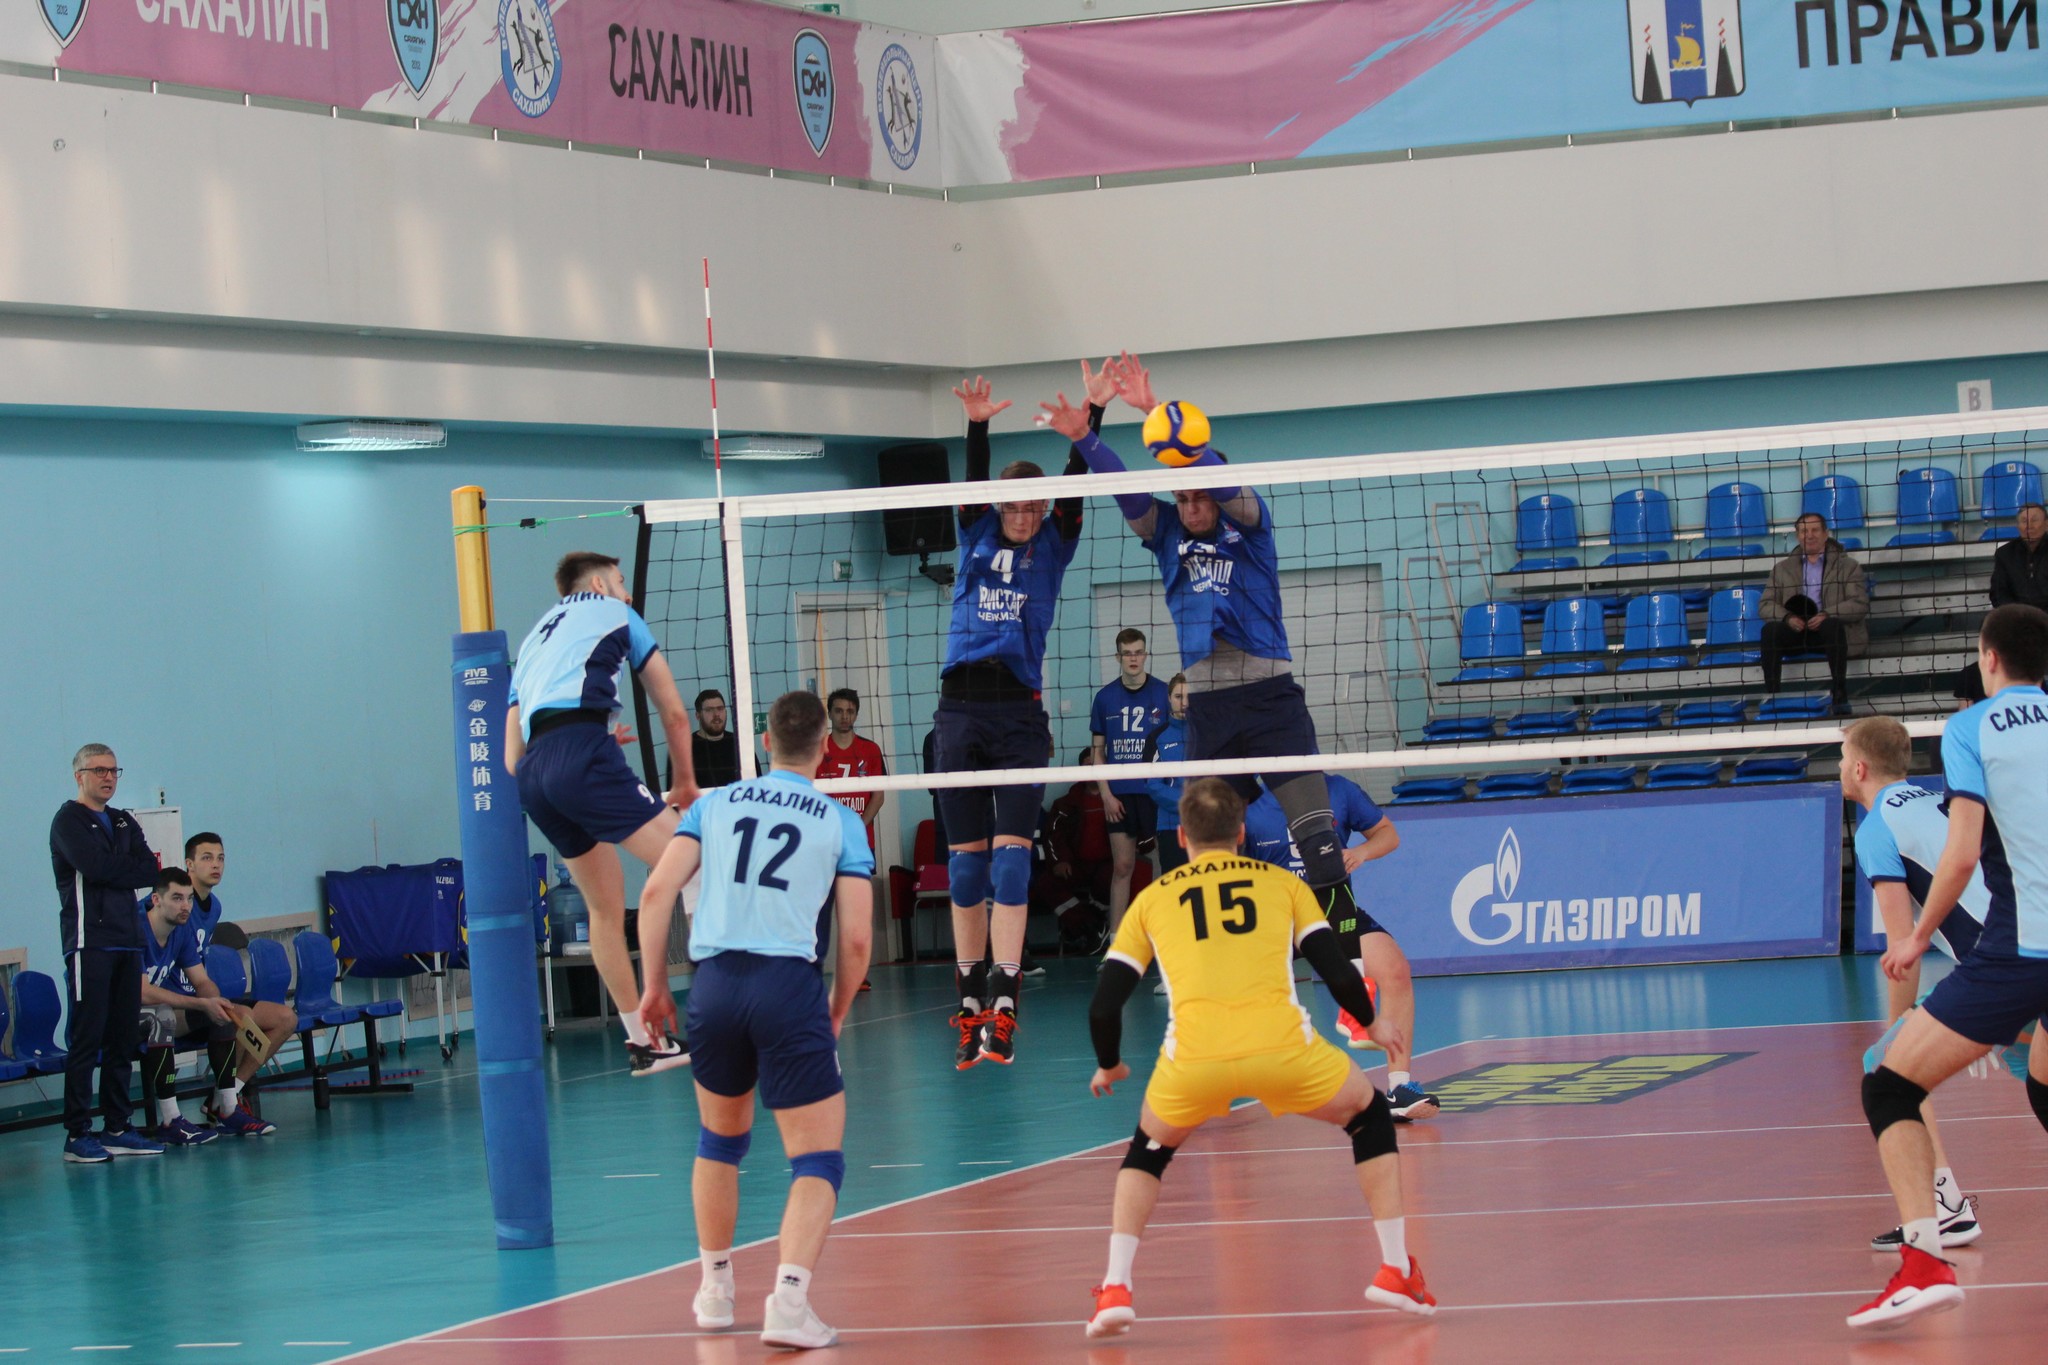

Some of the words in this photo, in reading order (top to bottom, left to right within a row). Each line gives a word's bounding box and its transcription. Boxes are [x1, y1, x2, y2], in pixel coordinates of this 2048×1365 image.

[1795, 0, 2040, 69] ПРАВИ
[608, 23, 753, 118] САХАЛИН
[512, 87, 551, 116] САХАЛИН
[990, 548, 1014, 584] 4
[464, 667, 488, 679] FIVB
[1121, 706, 1145, 732] 12
[1989, 703, 2048, 732] САХА
[469, 717, 492, 812] 金陵体育
[837, 763, 851, 779] 7
[638, 783, 655, 804] 9
[729, 786, 829, 820] САХАЛИН
[733, 816, 802, 892] 12
[1160, 860, 1268, 886] САХАЛИН
[1179, 879, 1258, 942] 15
[1526, 892, 1702, 944] ГАЗПРОМ
[245, 1029, 263, 1052] 5
